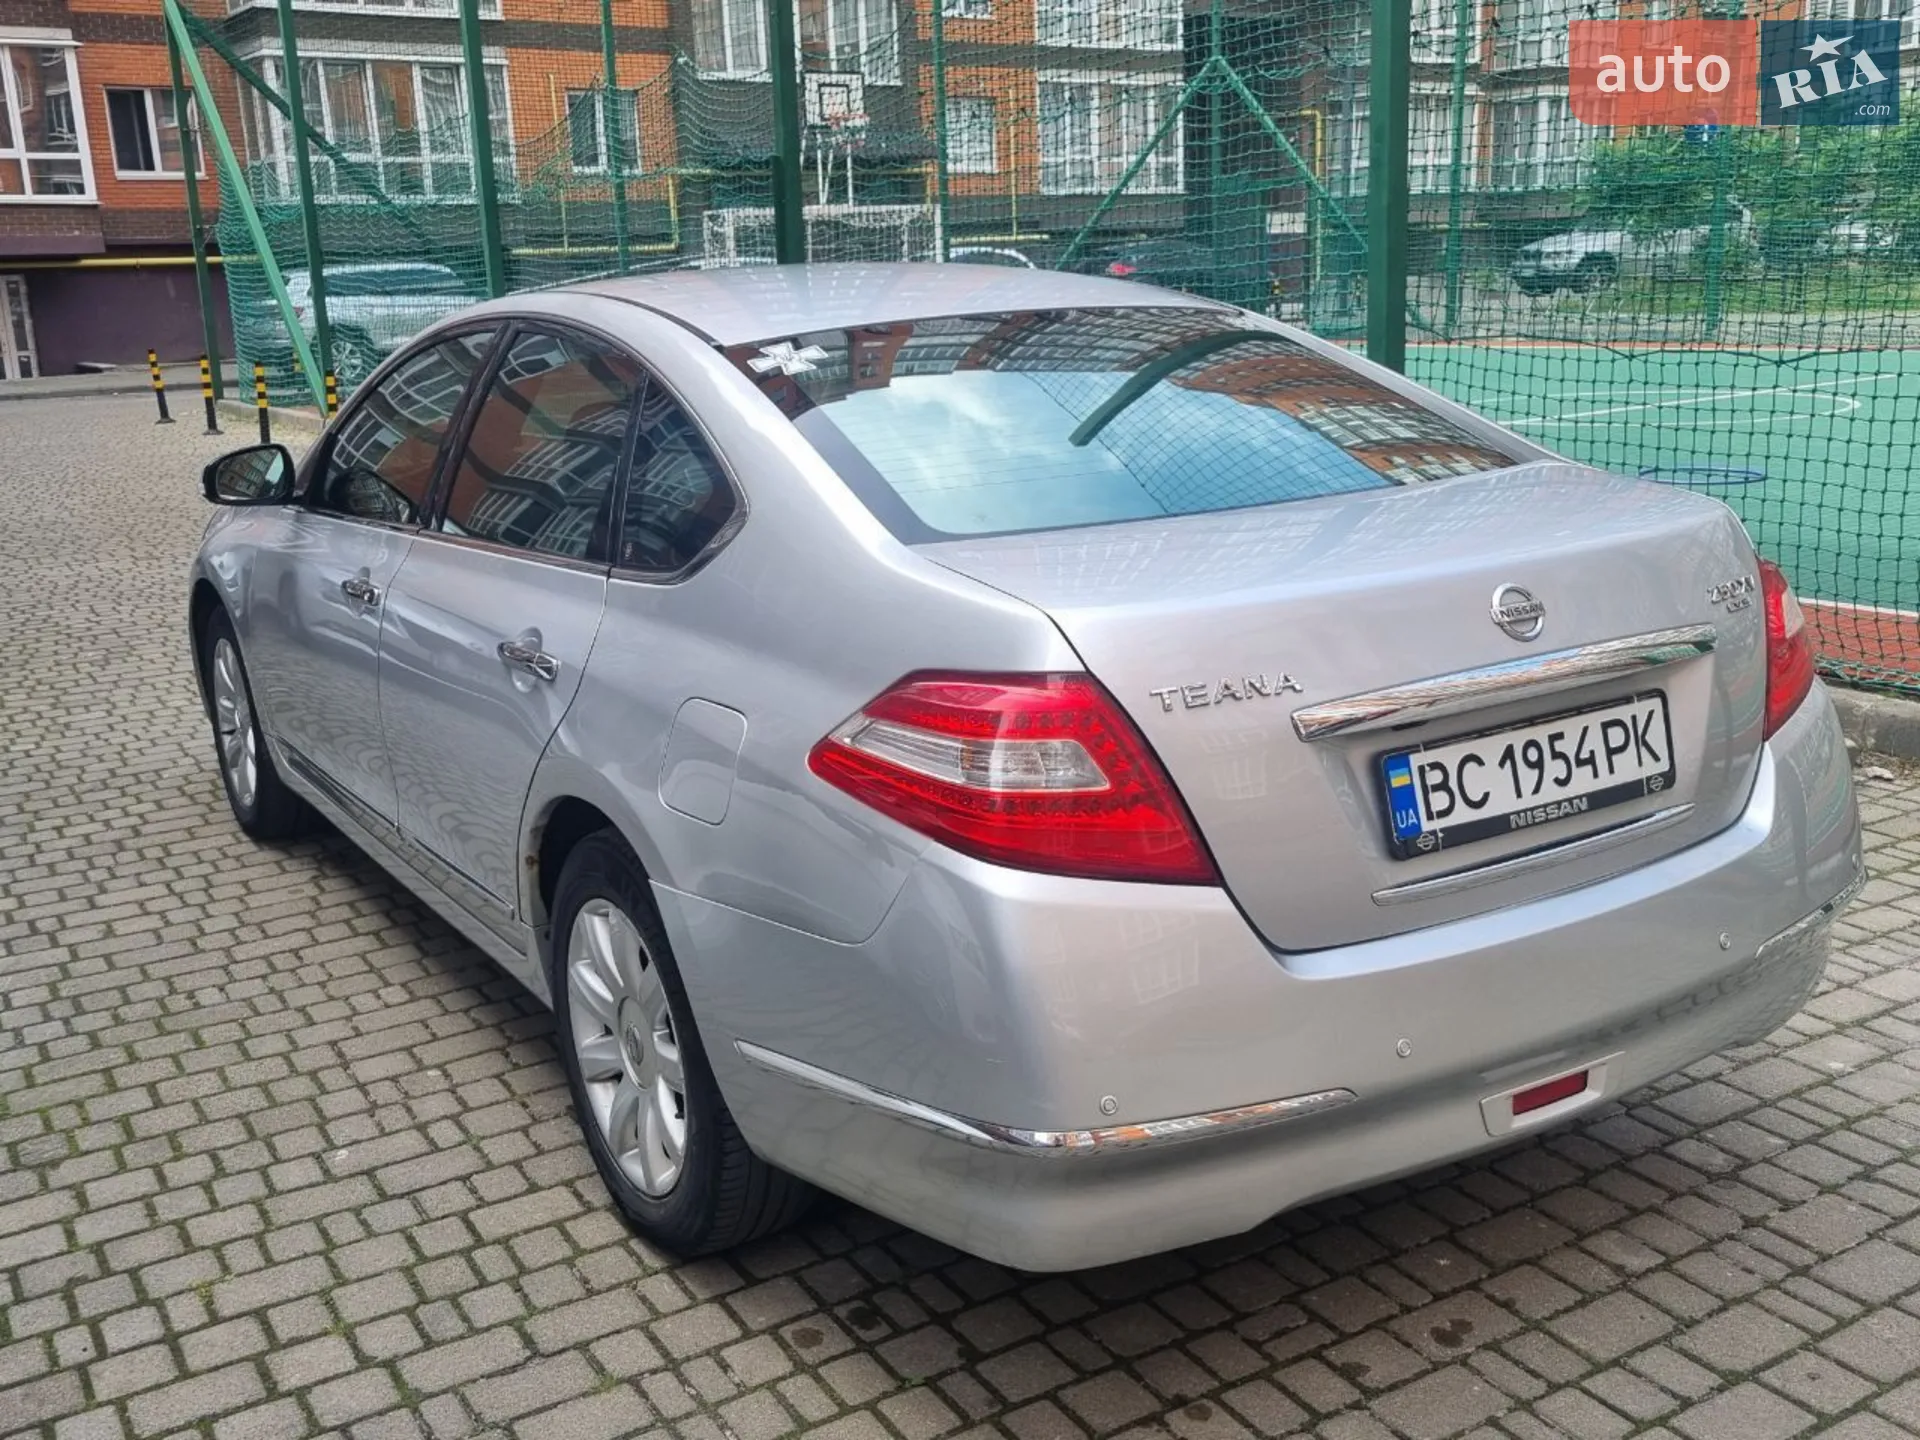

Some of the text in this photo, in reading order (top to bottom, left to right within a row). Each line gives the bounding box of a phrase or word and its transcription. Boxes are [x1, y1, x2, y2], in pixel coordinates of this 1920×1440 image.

[1499, 602, 1545, 619] NISSAN
[1150, 671, 1304, 712] TEANA
[1417, 708, 1662, 822] BC 1954 PK
[1396, 811, 1418, 829] UA
[1510, 796, 1588, 829] NISSAN
